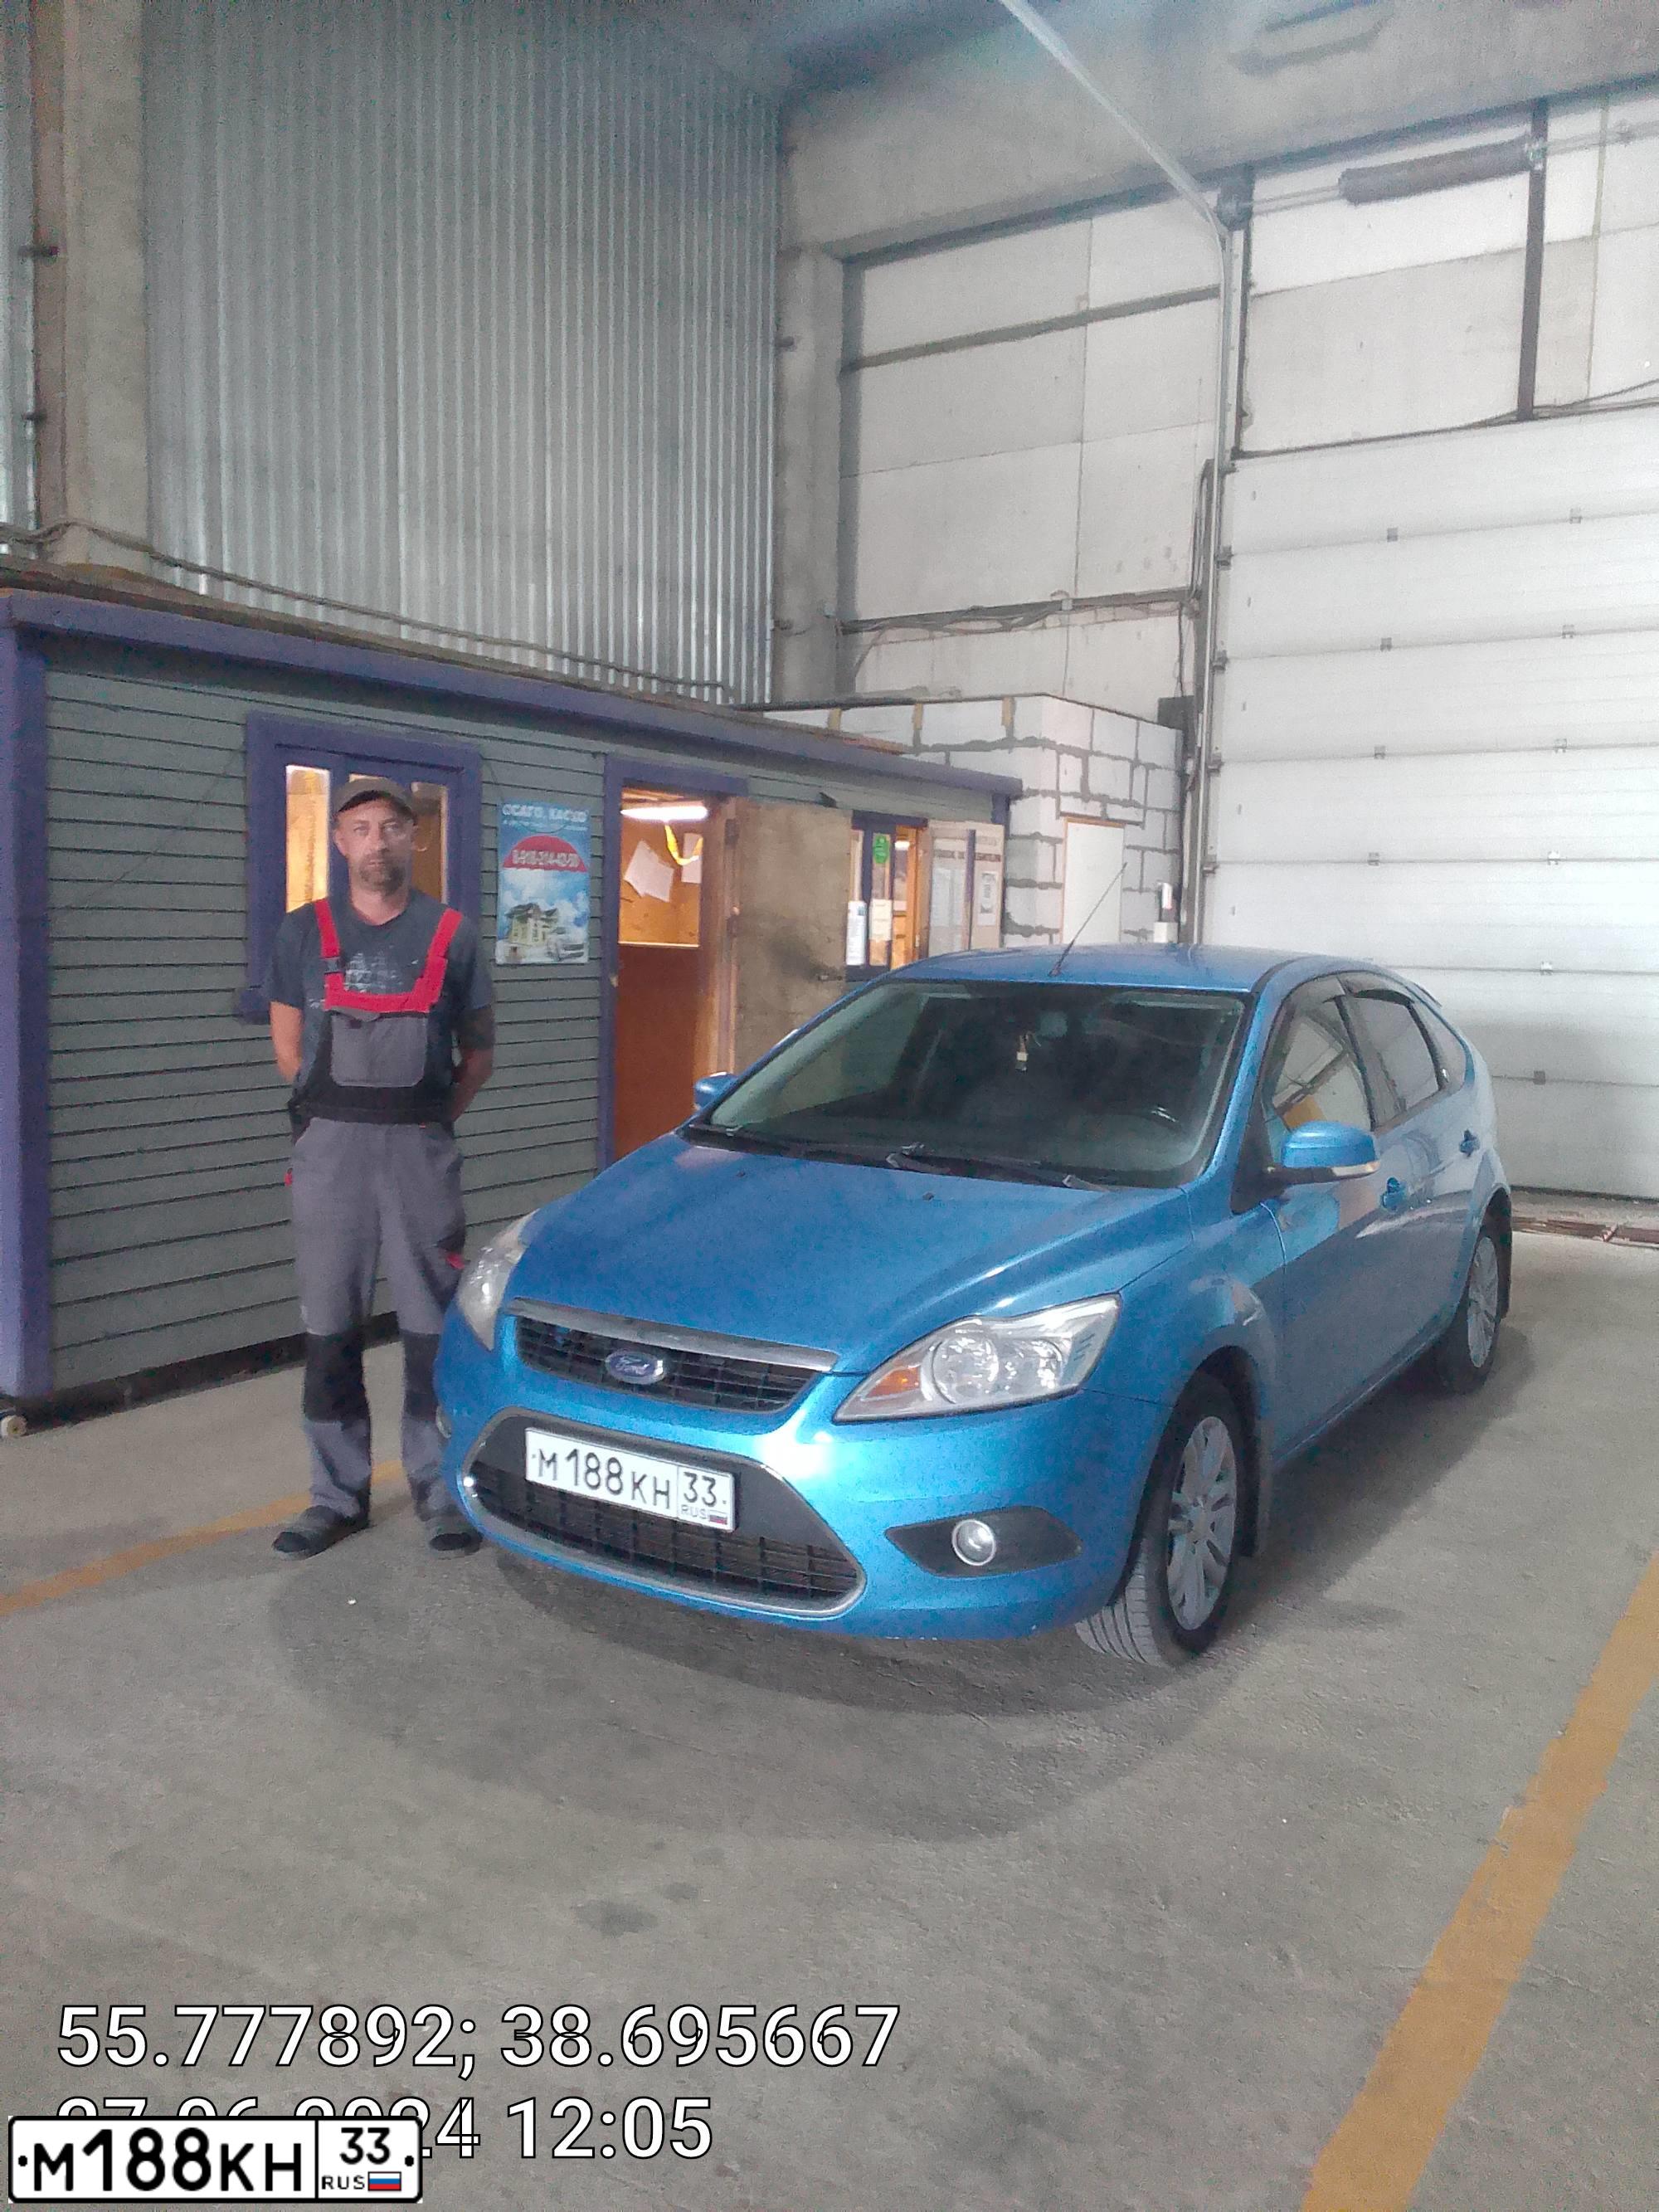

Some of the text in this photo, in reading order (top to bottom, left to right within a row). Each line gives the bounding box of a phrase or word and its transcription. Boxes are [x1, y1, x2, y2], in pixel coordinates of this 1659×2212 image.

[538, 1449, 717, 1509] М188КН 33
[680, 1503, 708, 1520] RUS
